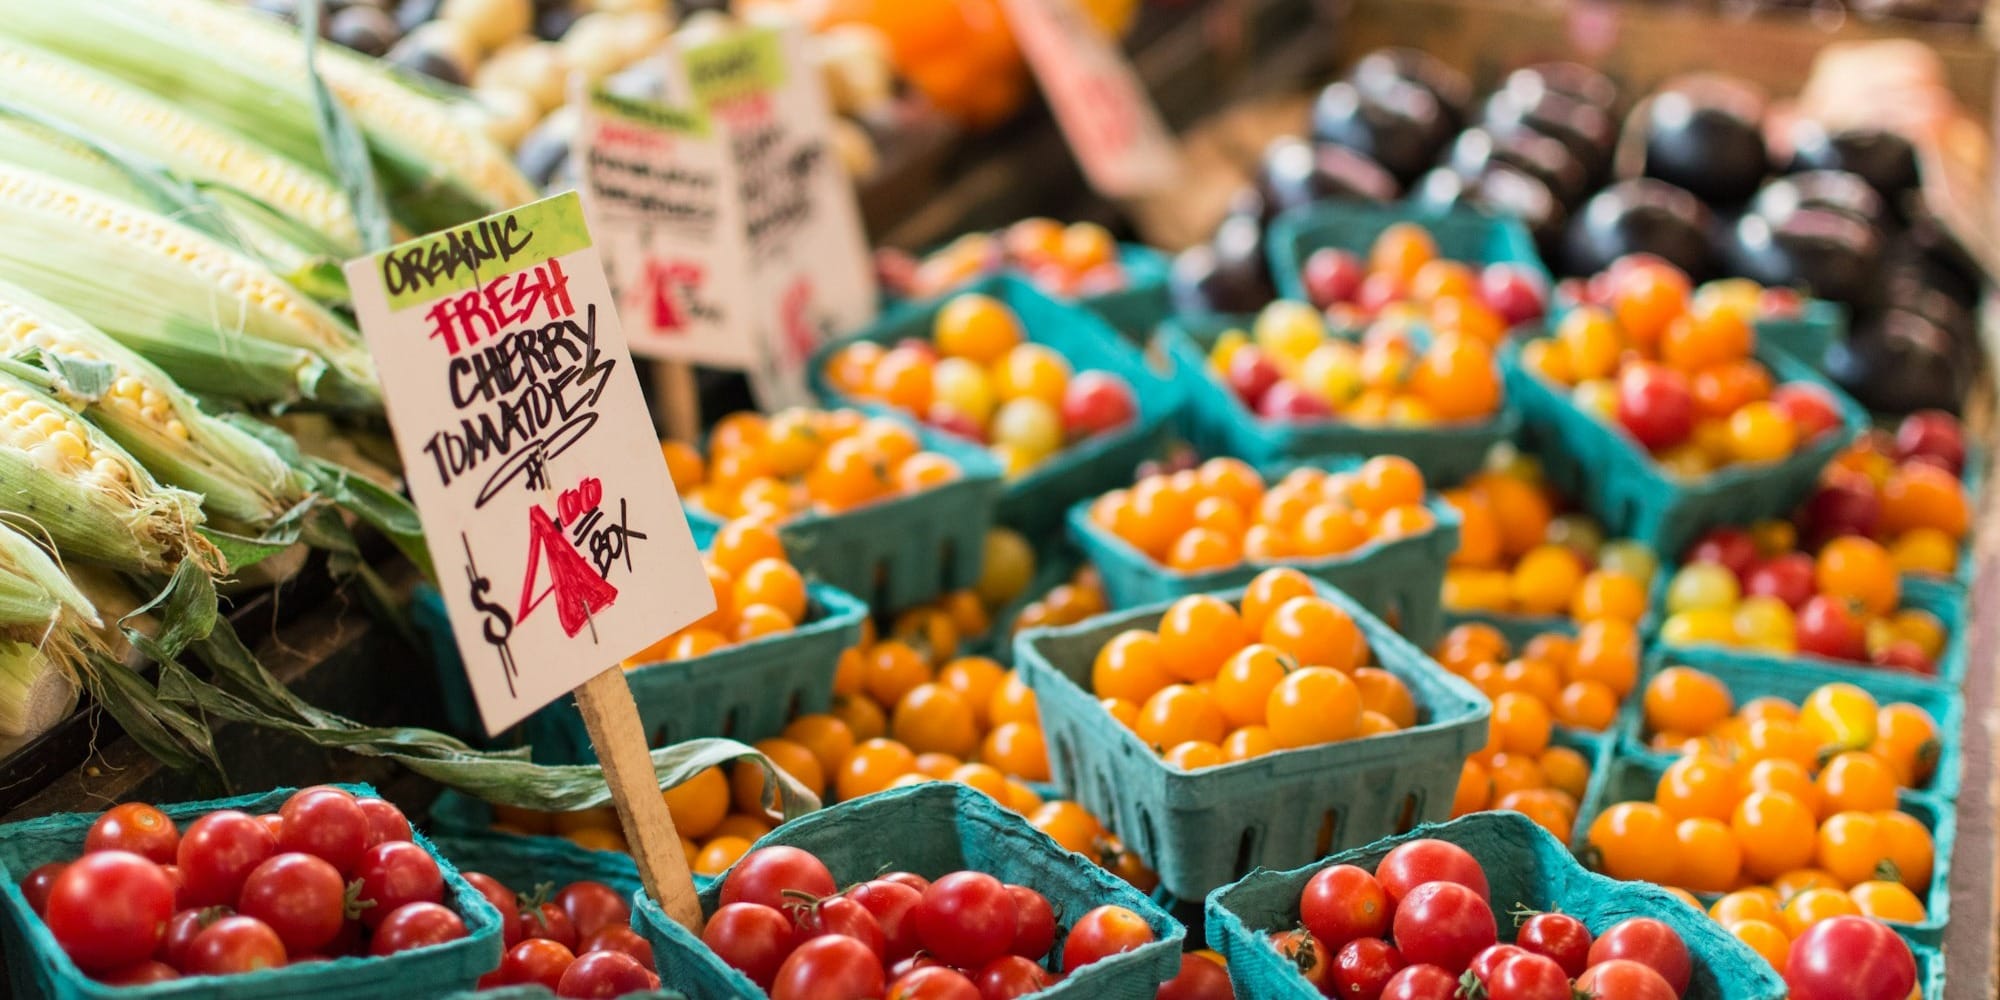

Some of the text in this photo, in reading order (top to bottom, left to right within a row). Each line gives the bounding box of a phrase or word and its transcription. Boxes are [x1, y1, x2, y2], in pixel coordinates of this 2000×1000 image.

[382, 214, 533, 295] ORGANIC
[425, 257, 575, 355] FRESH
[448, 304, 600, 409] CHERRY
[423, 359, 615, 486] TOMATOES
[589, 498, 647, 580] BOX
